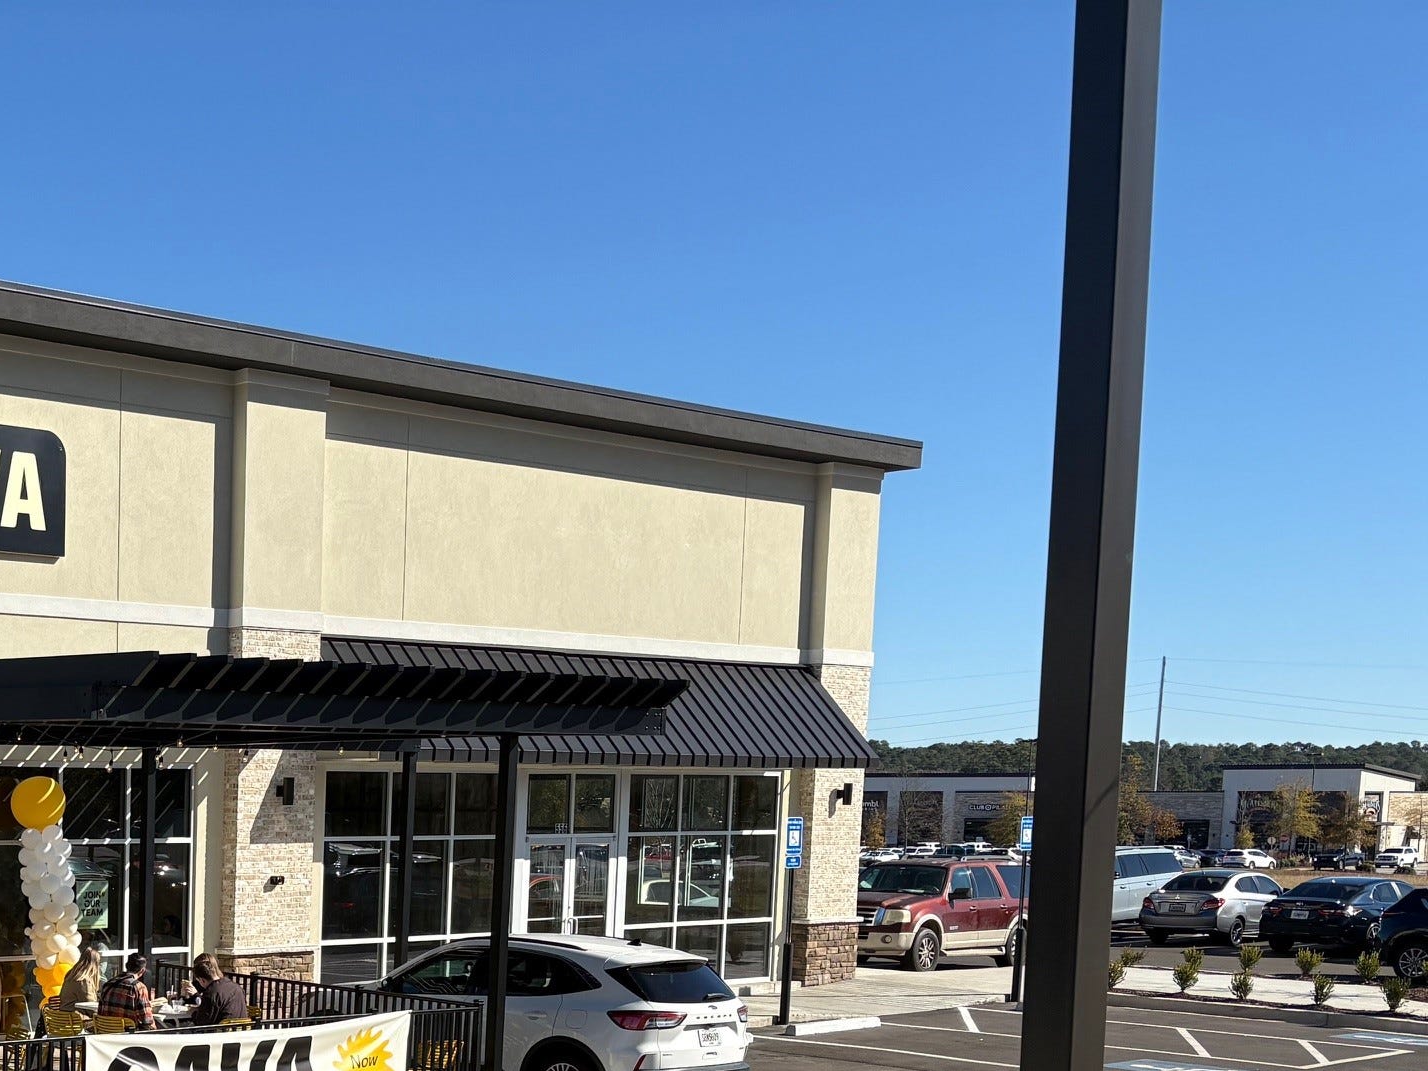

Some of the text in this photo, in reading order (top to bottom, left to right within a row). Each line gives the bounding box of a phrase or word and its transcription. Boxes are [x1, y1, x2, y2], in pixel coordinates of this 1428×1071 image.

[83, 891, 102, 899] JOIN
[84, 900, 101, 908] OUR
[82, 909, 104, 917] TEAM
[350, 1055, 378, 1069] Now
